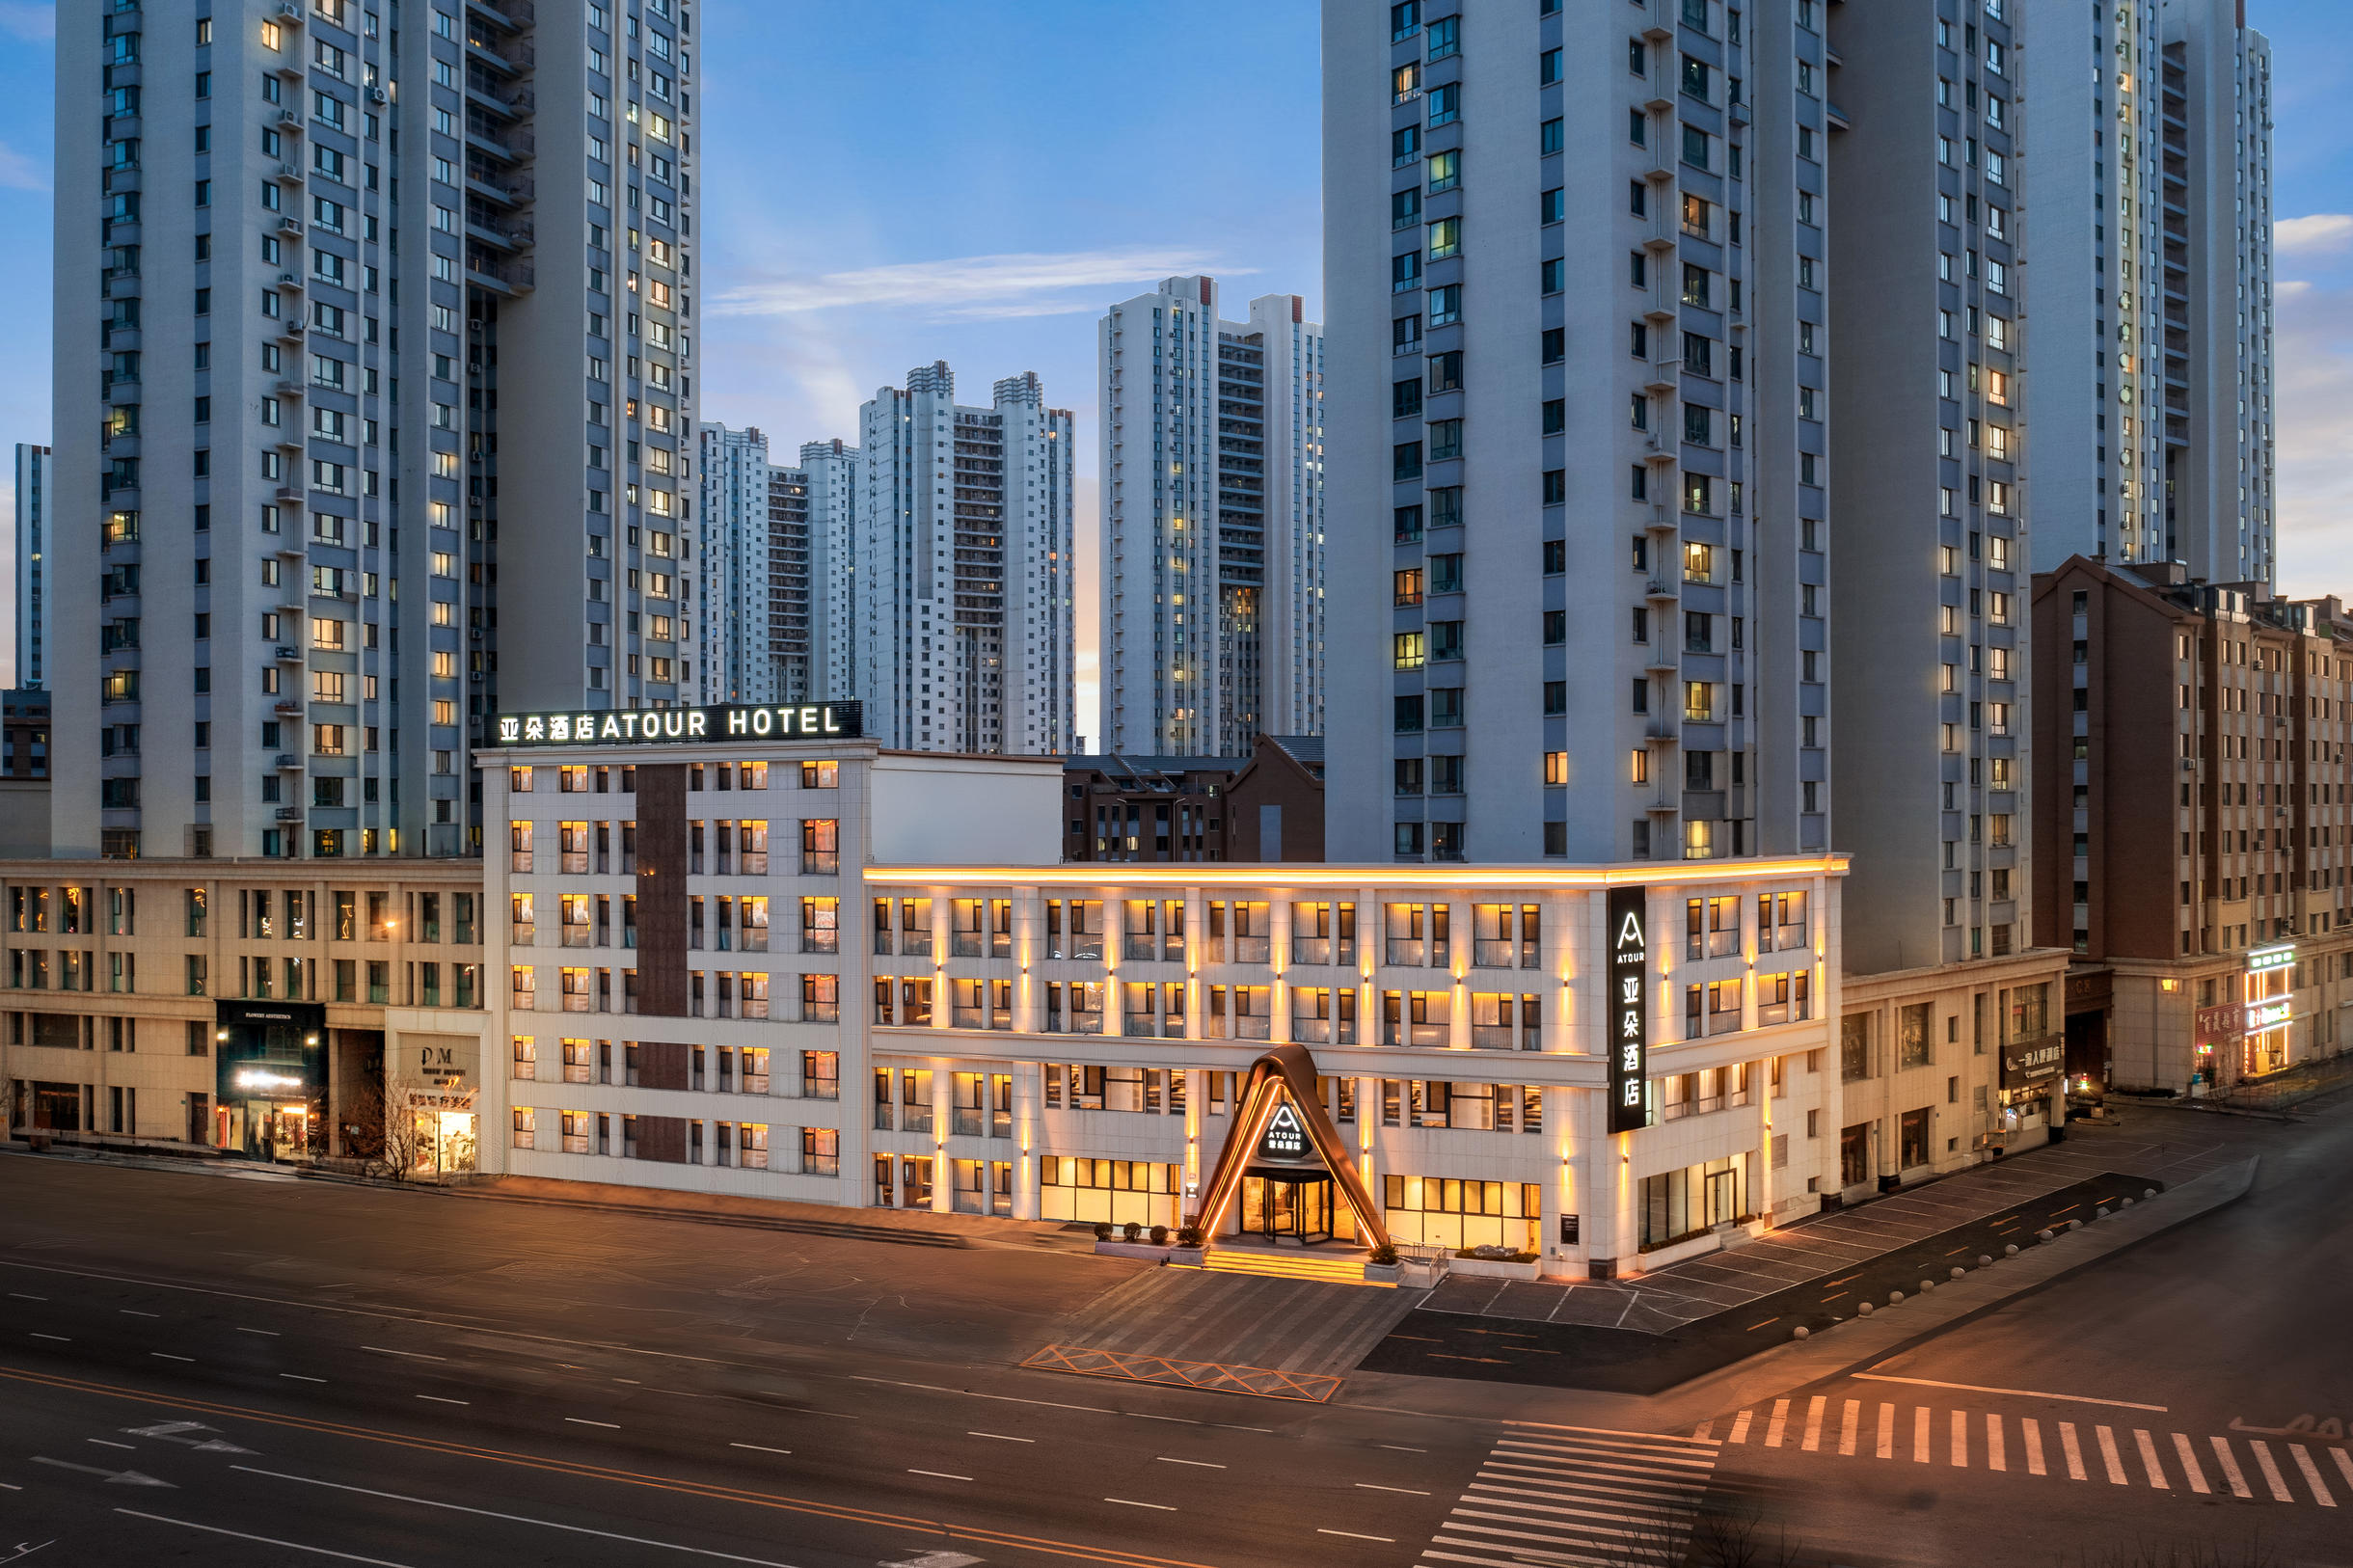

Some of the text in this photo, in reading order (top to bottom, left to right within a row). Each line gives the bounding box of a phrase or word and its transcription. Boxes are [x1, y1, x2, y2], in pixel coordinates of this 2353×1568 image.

[500, 716, 595, 742] 亚朵酒店
[602, 707, 840, 738] ATOUR HOTEL
[1617, 952, 1645, 964] ATOUR
[1623, 977, 1639, 1108] 亚朵酒店
[1268, 1131, 1301, 1141] ATOUR
